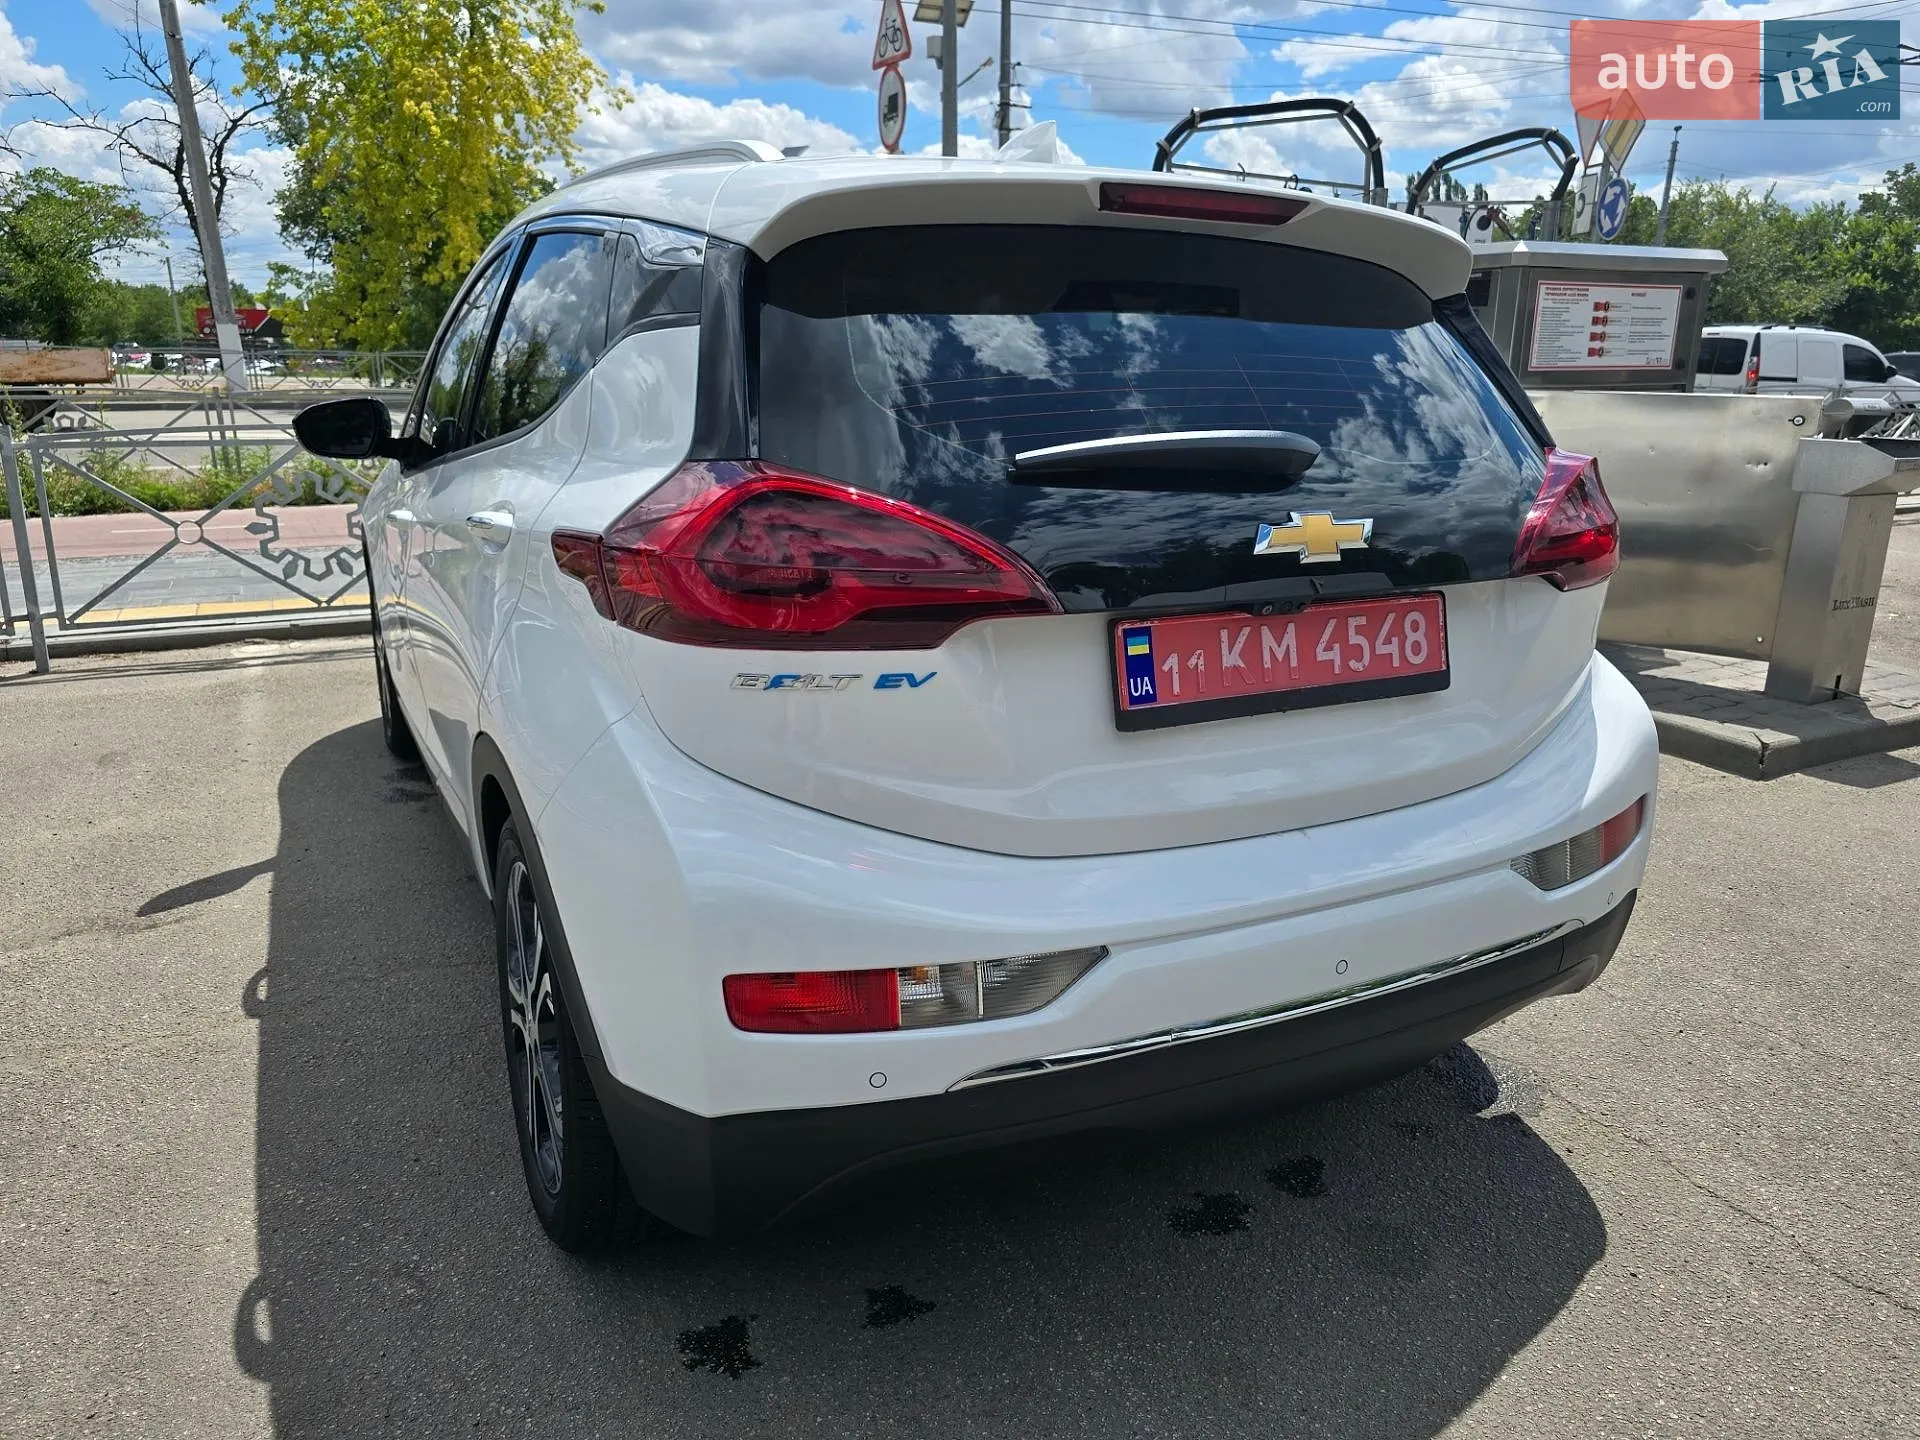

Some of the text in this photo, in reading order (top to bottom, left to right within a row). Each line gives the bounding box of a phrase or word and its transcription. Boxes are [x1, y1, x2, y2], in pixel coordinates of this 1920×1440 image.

[1161, 611, 1428, 696] 11 KM 4548
[730, 671, 938, 691] BOLT EV
[1129, 676, 1153, 696] UA
